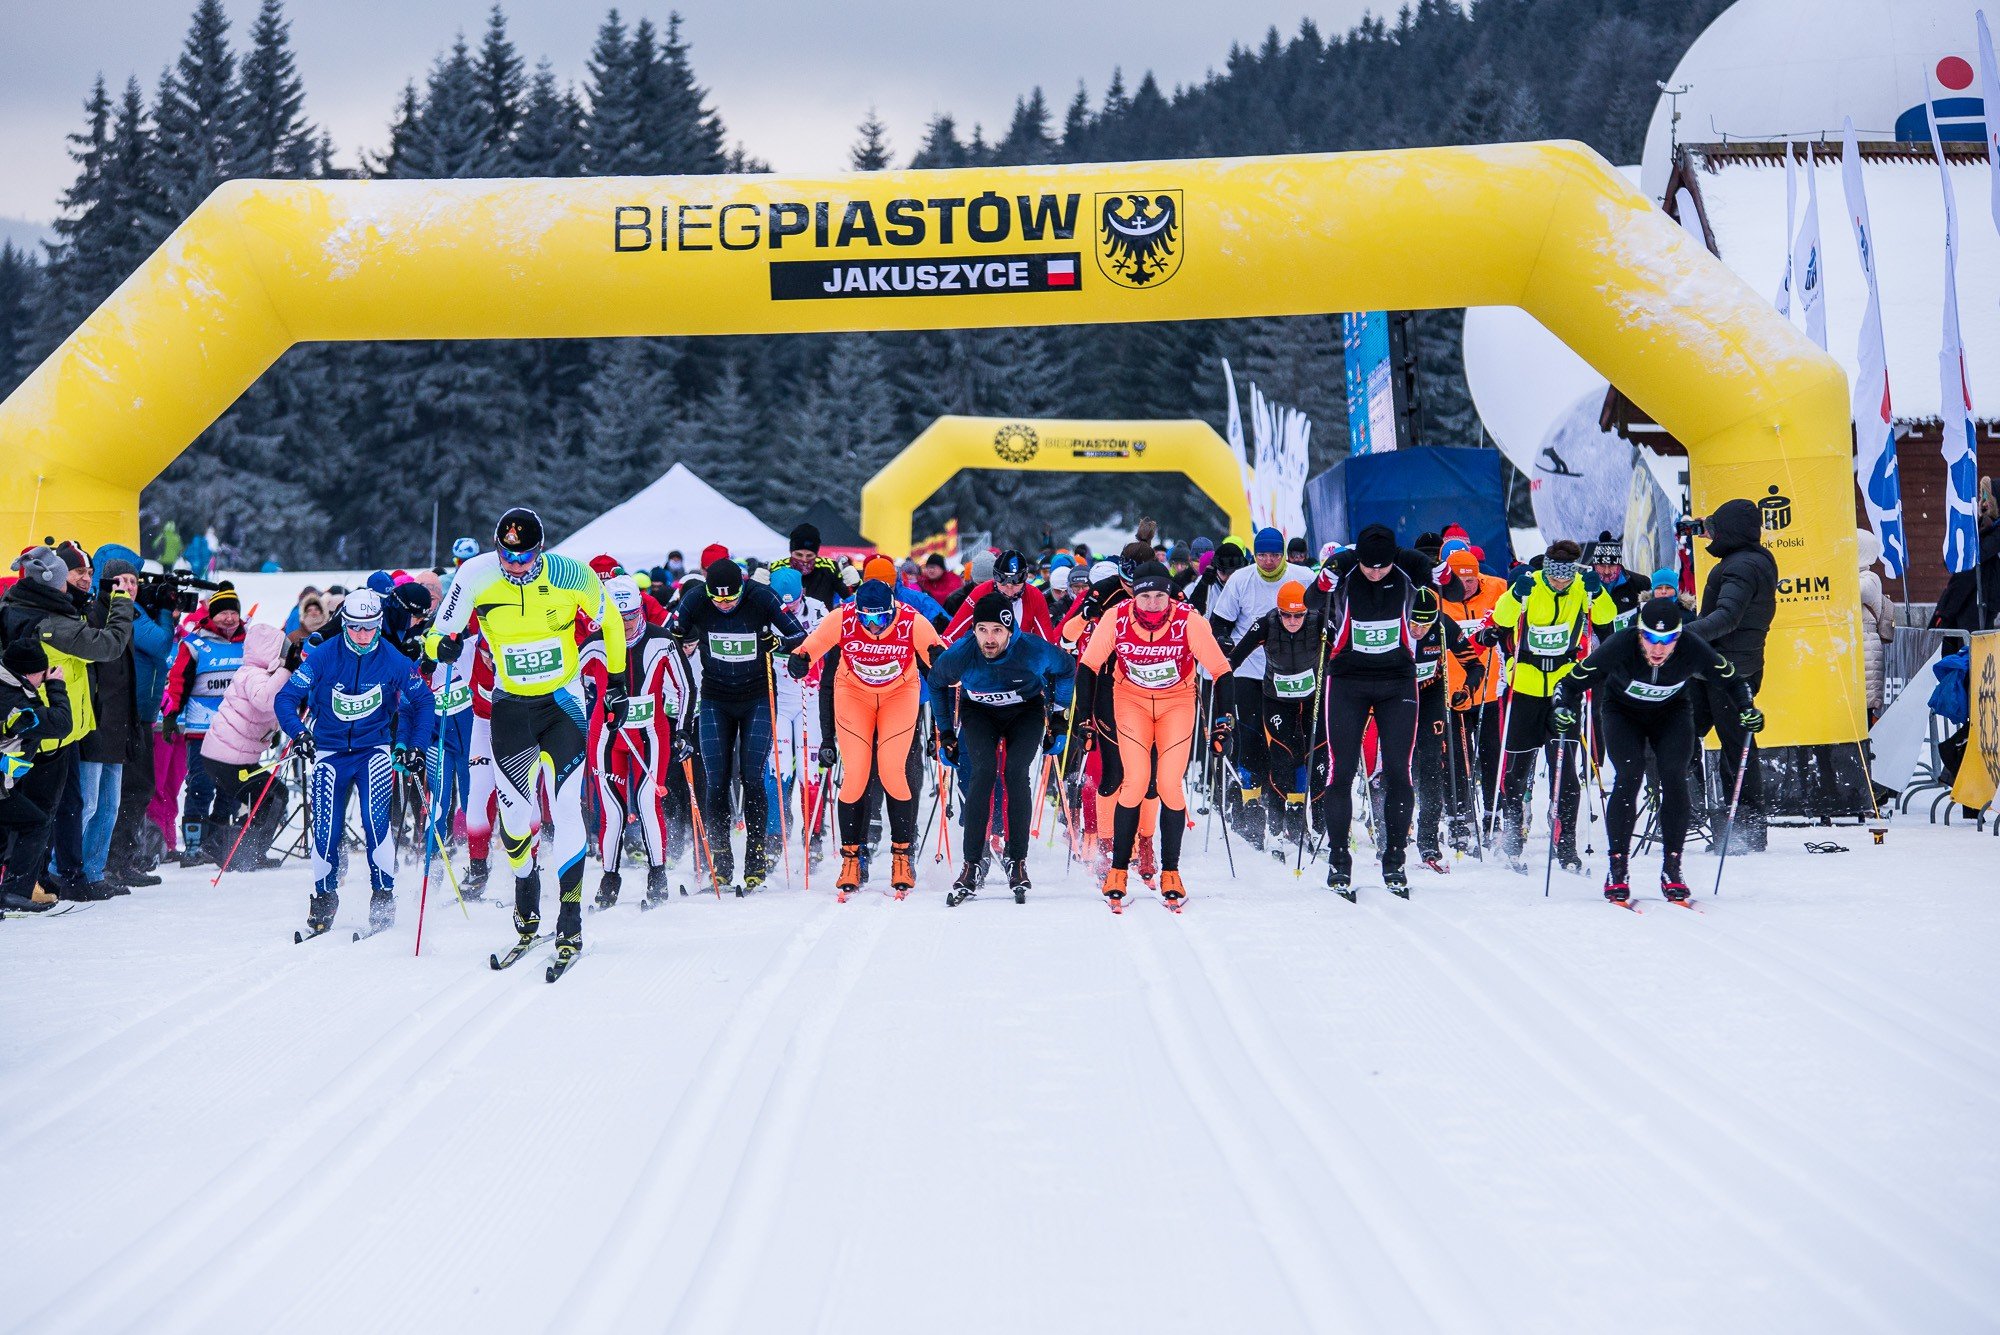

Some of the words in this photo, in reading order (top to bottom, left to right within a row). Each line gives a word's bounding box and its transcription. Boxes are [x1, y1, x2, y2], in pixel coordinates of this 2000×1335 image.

[822, 261, 1030, 292] JAKUSZYCE
[1776, 537, 1804, 548] Polski
[1776, 576, 1830, 595] GHM
[442, 582, 462, 621] sportful
[1365, 629, 1387, 642] 28
[1534, 632, 1563, 644] 144
[722, 640, 742, 652] 91
[862, 643, 908, 655] ENERVIT
[1133, 645, 1184, 656] ENERVIT
[514, 650, 553, 668] 292
[207, 678, 232, 690] CONT
[1286, 679, 1303, 689] 17
[340, 697, 374, 712] 380
[628, 704, 647, 717] 91
